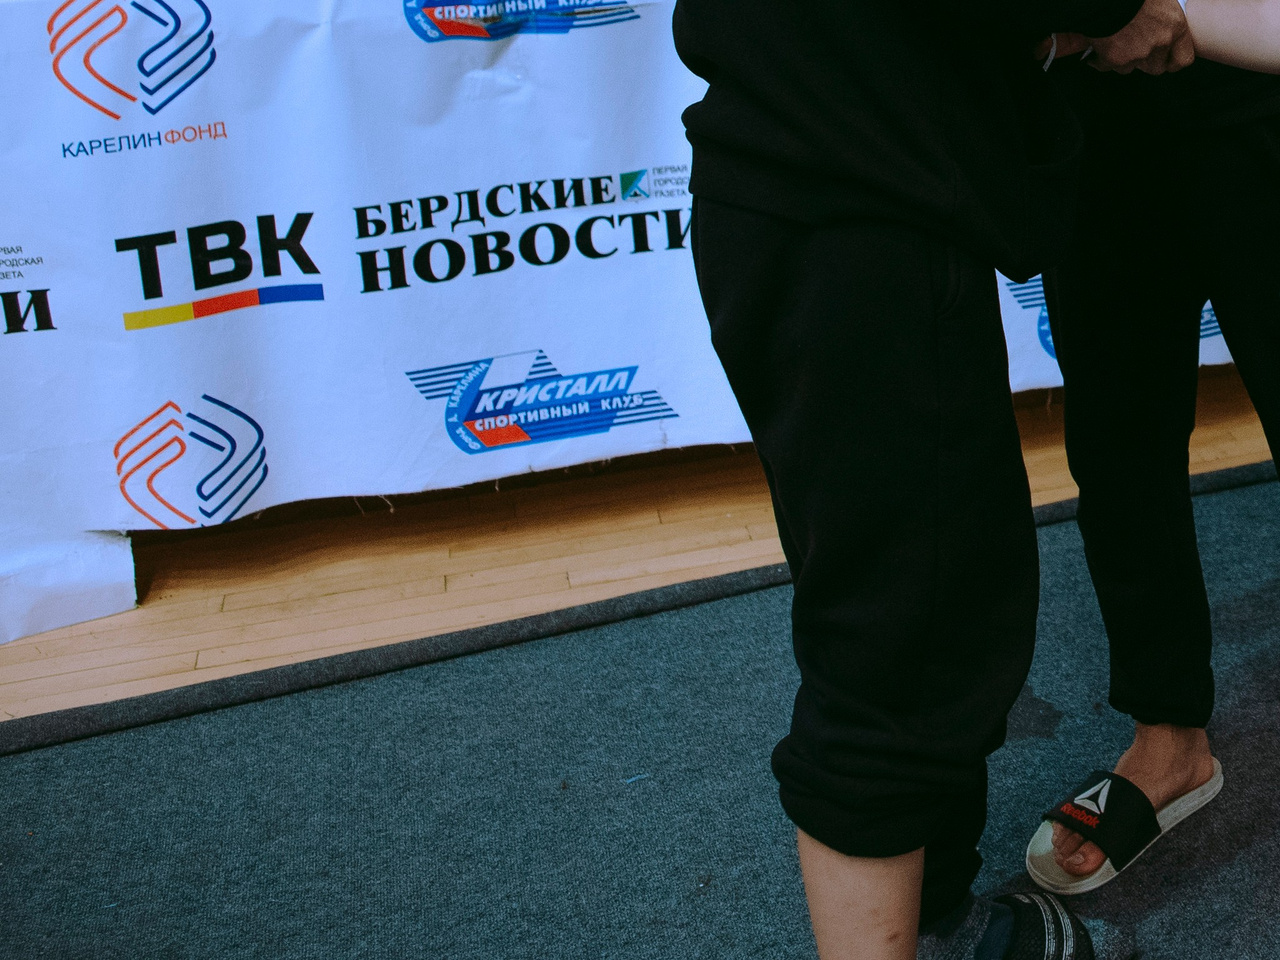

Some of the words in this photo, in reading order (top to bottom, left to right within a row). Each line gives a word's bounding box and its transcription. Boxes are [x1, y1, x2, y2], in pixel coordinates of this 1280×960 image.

[353, 175, 616, 240] БЕРДСКИЕ
[114, 212, 321, 300] ТВК
[474, 371, 629, 414] КРИСТАЛЛ
[474, 401, 590, 432] СПОРТИВНЫЙ
[601, 394, 644, 411] КЛУБ
[1060, 803, 1100, 828] Reebok
